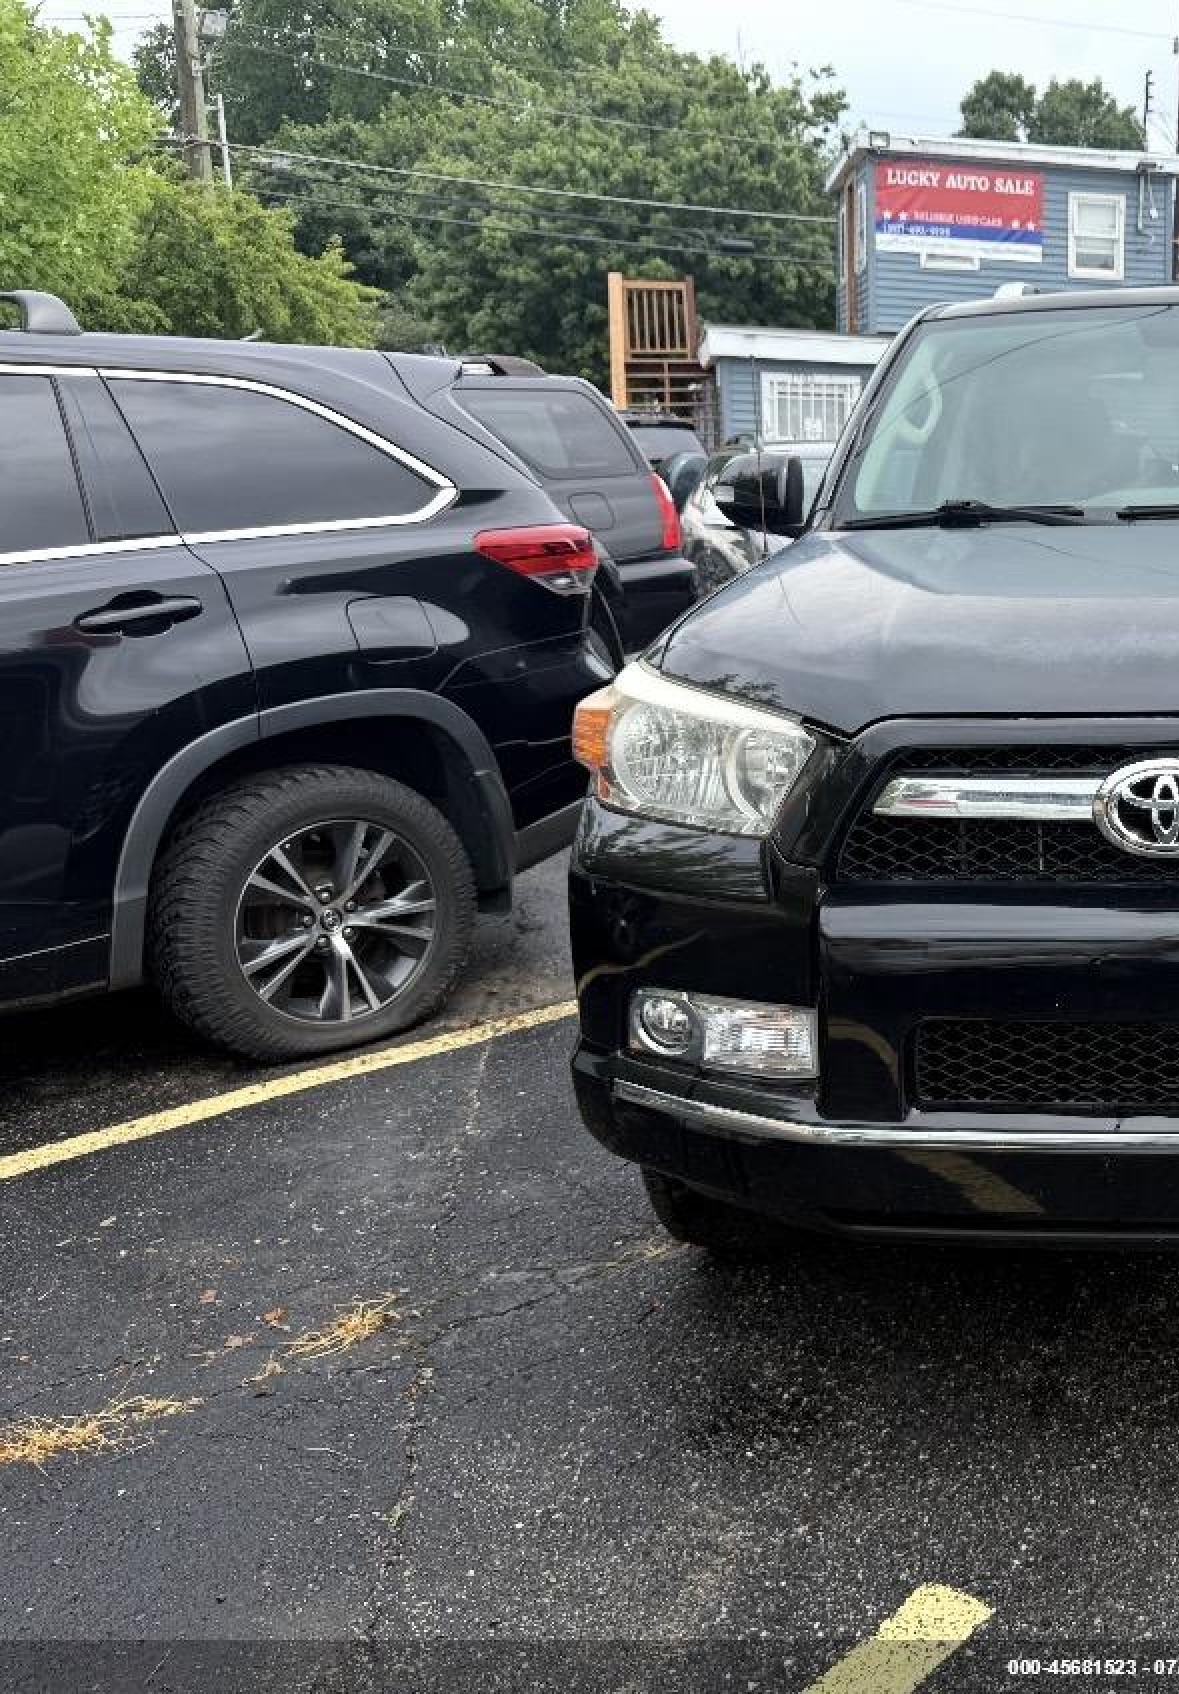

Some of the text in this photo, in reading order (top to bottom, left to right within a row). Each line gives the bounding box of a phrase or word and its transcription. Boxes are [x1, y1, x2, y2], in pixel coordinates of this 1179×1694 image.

[887, 168, 1035, 196] LUCKY AUTO SALE
